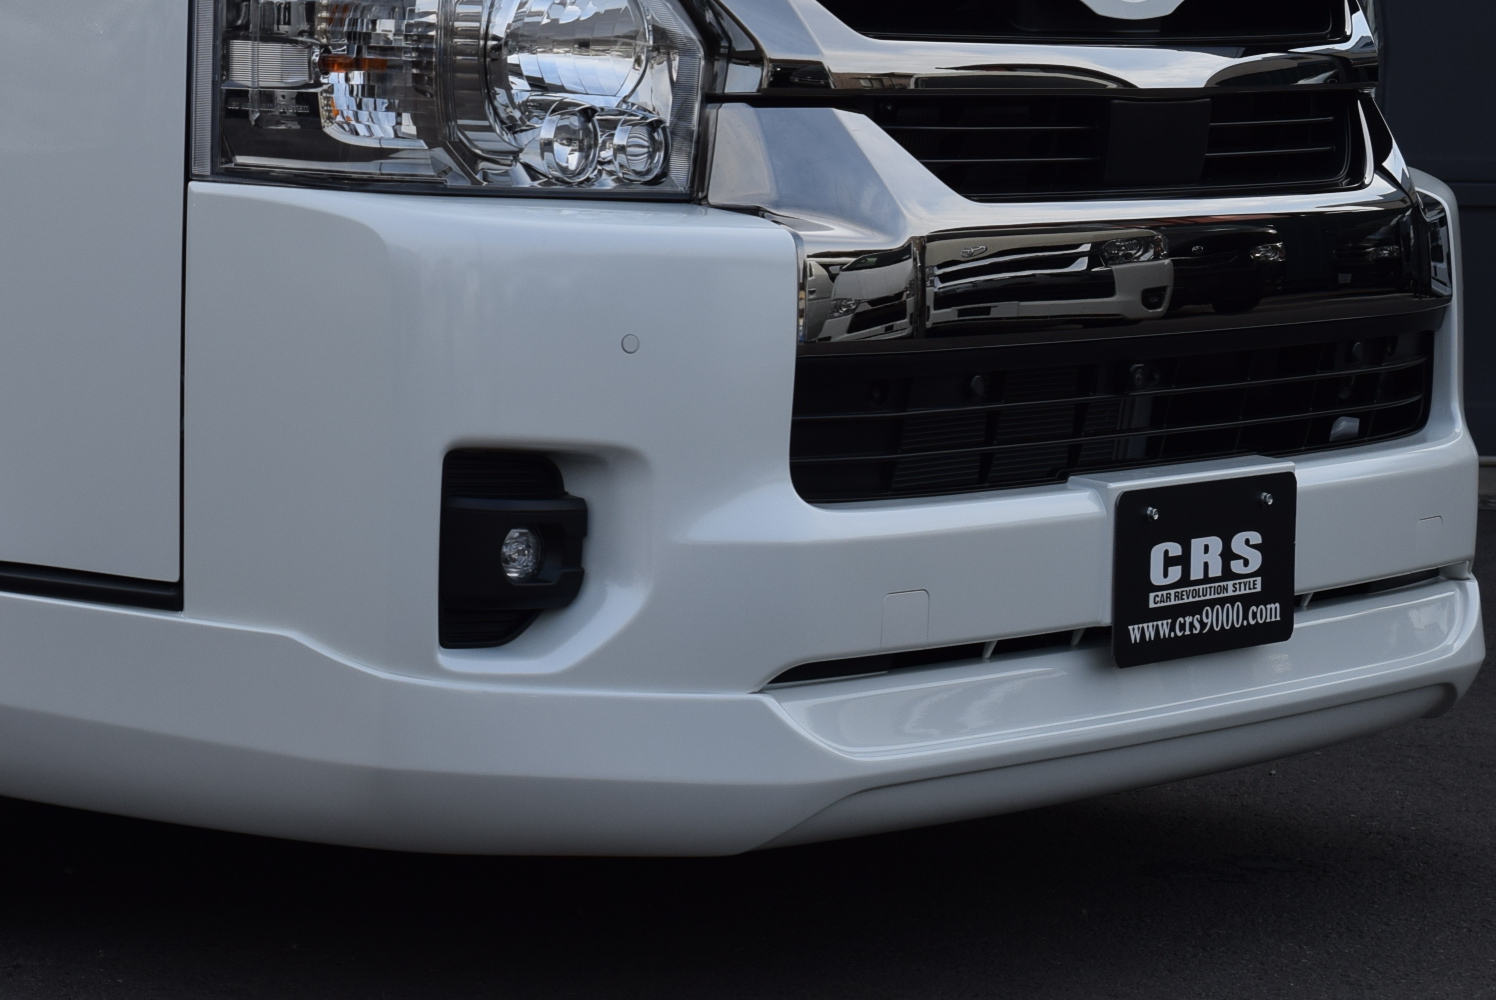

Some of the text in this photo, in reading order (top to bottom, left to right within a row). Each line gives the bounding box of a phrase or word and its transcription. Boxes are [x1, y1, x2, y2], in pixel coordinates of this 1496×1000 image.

[1149, 531, 1263, 586] CRS
[1153, 579, 1258, 605] CAR REVOLUTION STYLE
[1128, 602, 1281, 644] www.crs9000.com
